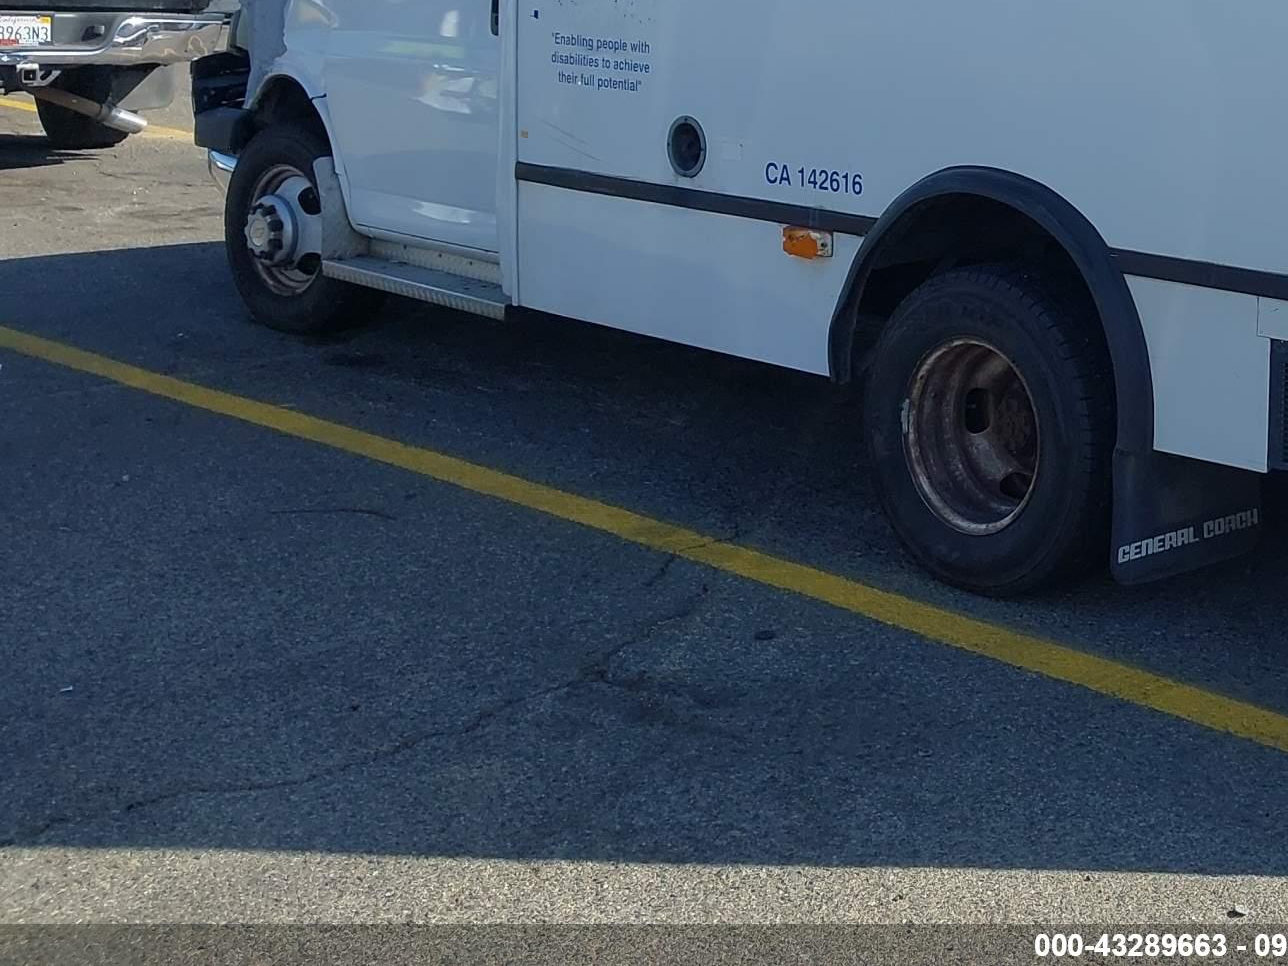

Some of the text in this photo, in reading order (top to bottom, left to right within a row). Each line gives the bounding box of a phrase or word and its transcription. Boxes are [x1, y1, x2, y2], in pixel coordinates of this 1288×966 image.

[596, 38, 628, 53] people
[630, 40, 650, 54] with
[551, 51, 650, 74] disabilities to achieve
[558, 71, 577, 85] their
[581, 74, 595, 87] full
[765, 162, 863, 195] CA 142616
[1118, 508, 1259, 564] GENERAL COACH
